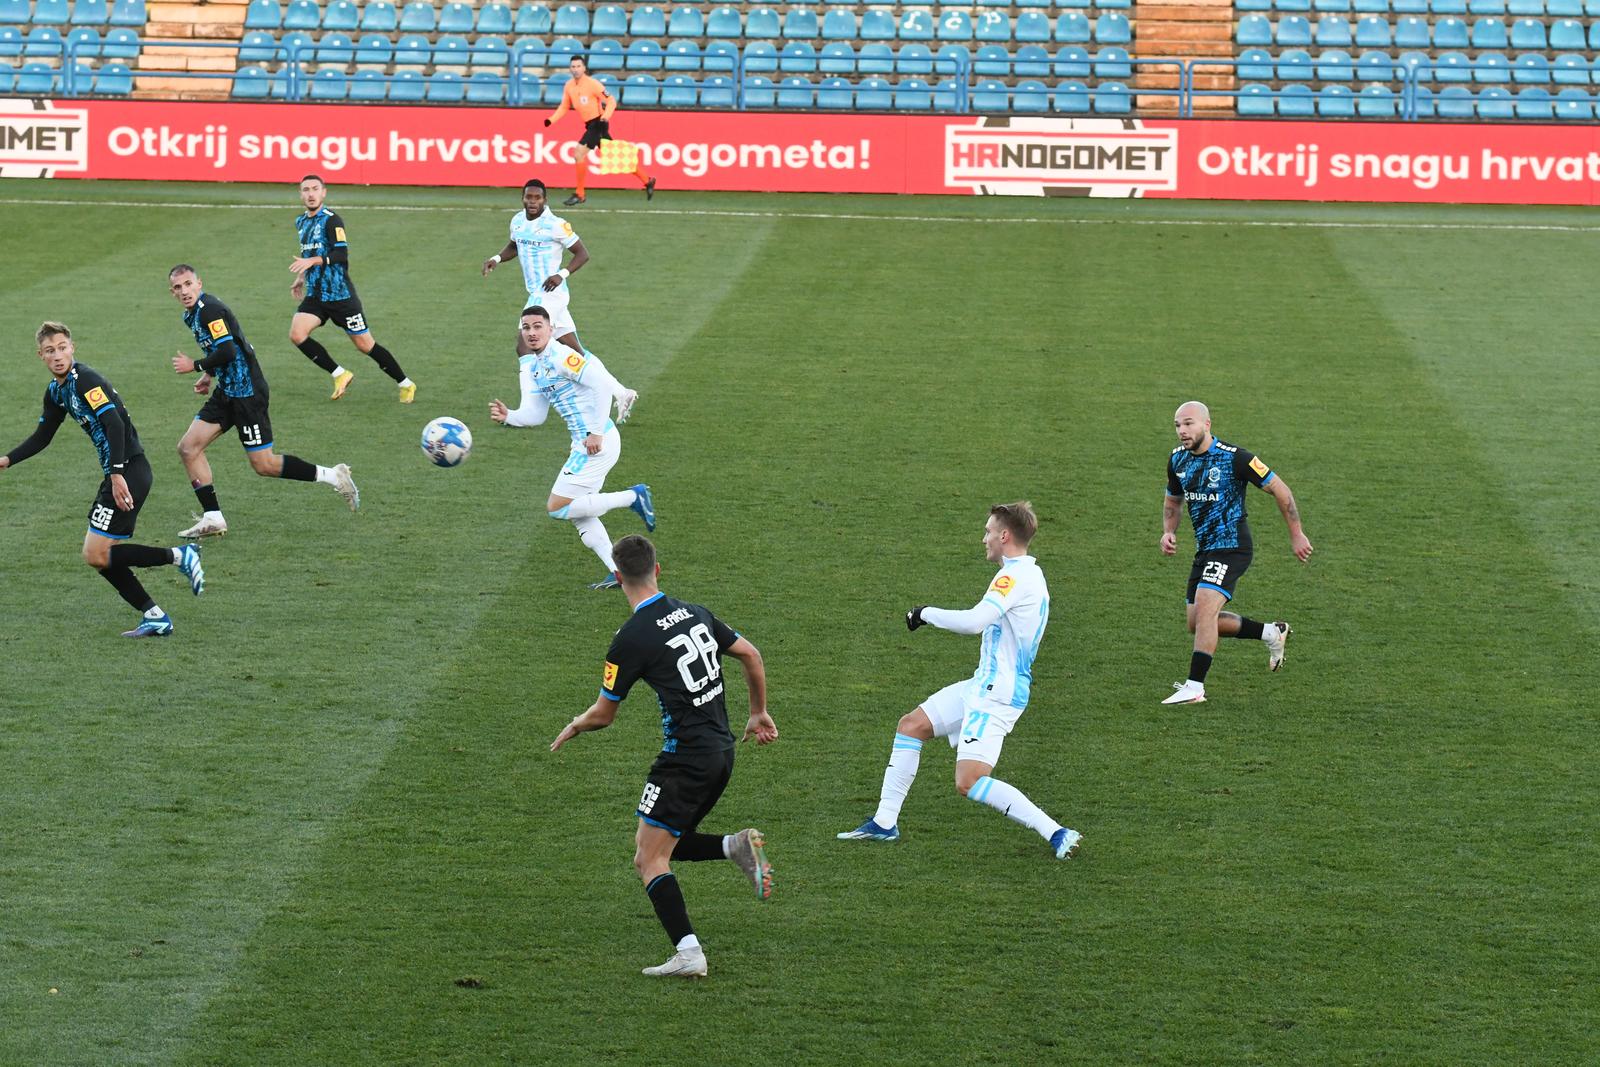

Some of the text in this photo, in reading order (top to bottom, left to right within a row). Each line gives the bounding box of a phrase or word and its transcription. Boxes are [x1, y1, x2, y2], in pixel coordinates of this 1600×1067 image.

[0, 125, 81, 151] MET
[107, 124, 228, 168] Otkrij
[239, 134, 377, 171] snagu
[951, 142, 1171, 171] HRNOGOMET
[1197, 143, 1319, 187] Otkrij
[1329, 153, 1470, 190] snagu
[1202, 561, 1222, 578] 23
[664, 622, 721, 693] 28
[962, 709, 991, 738] 21
